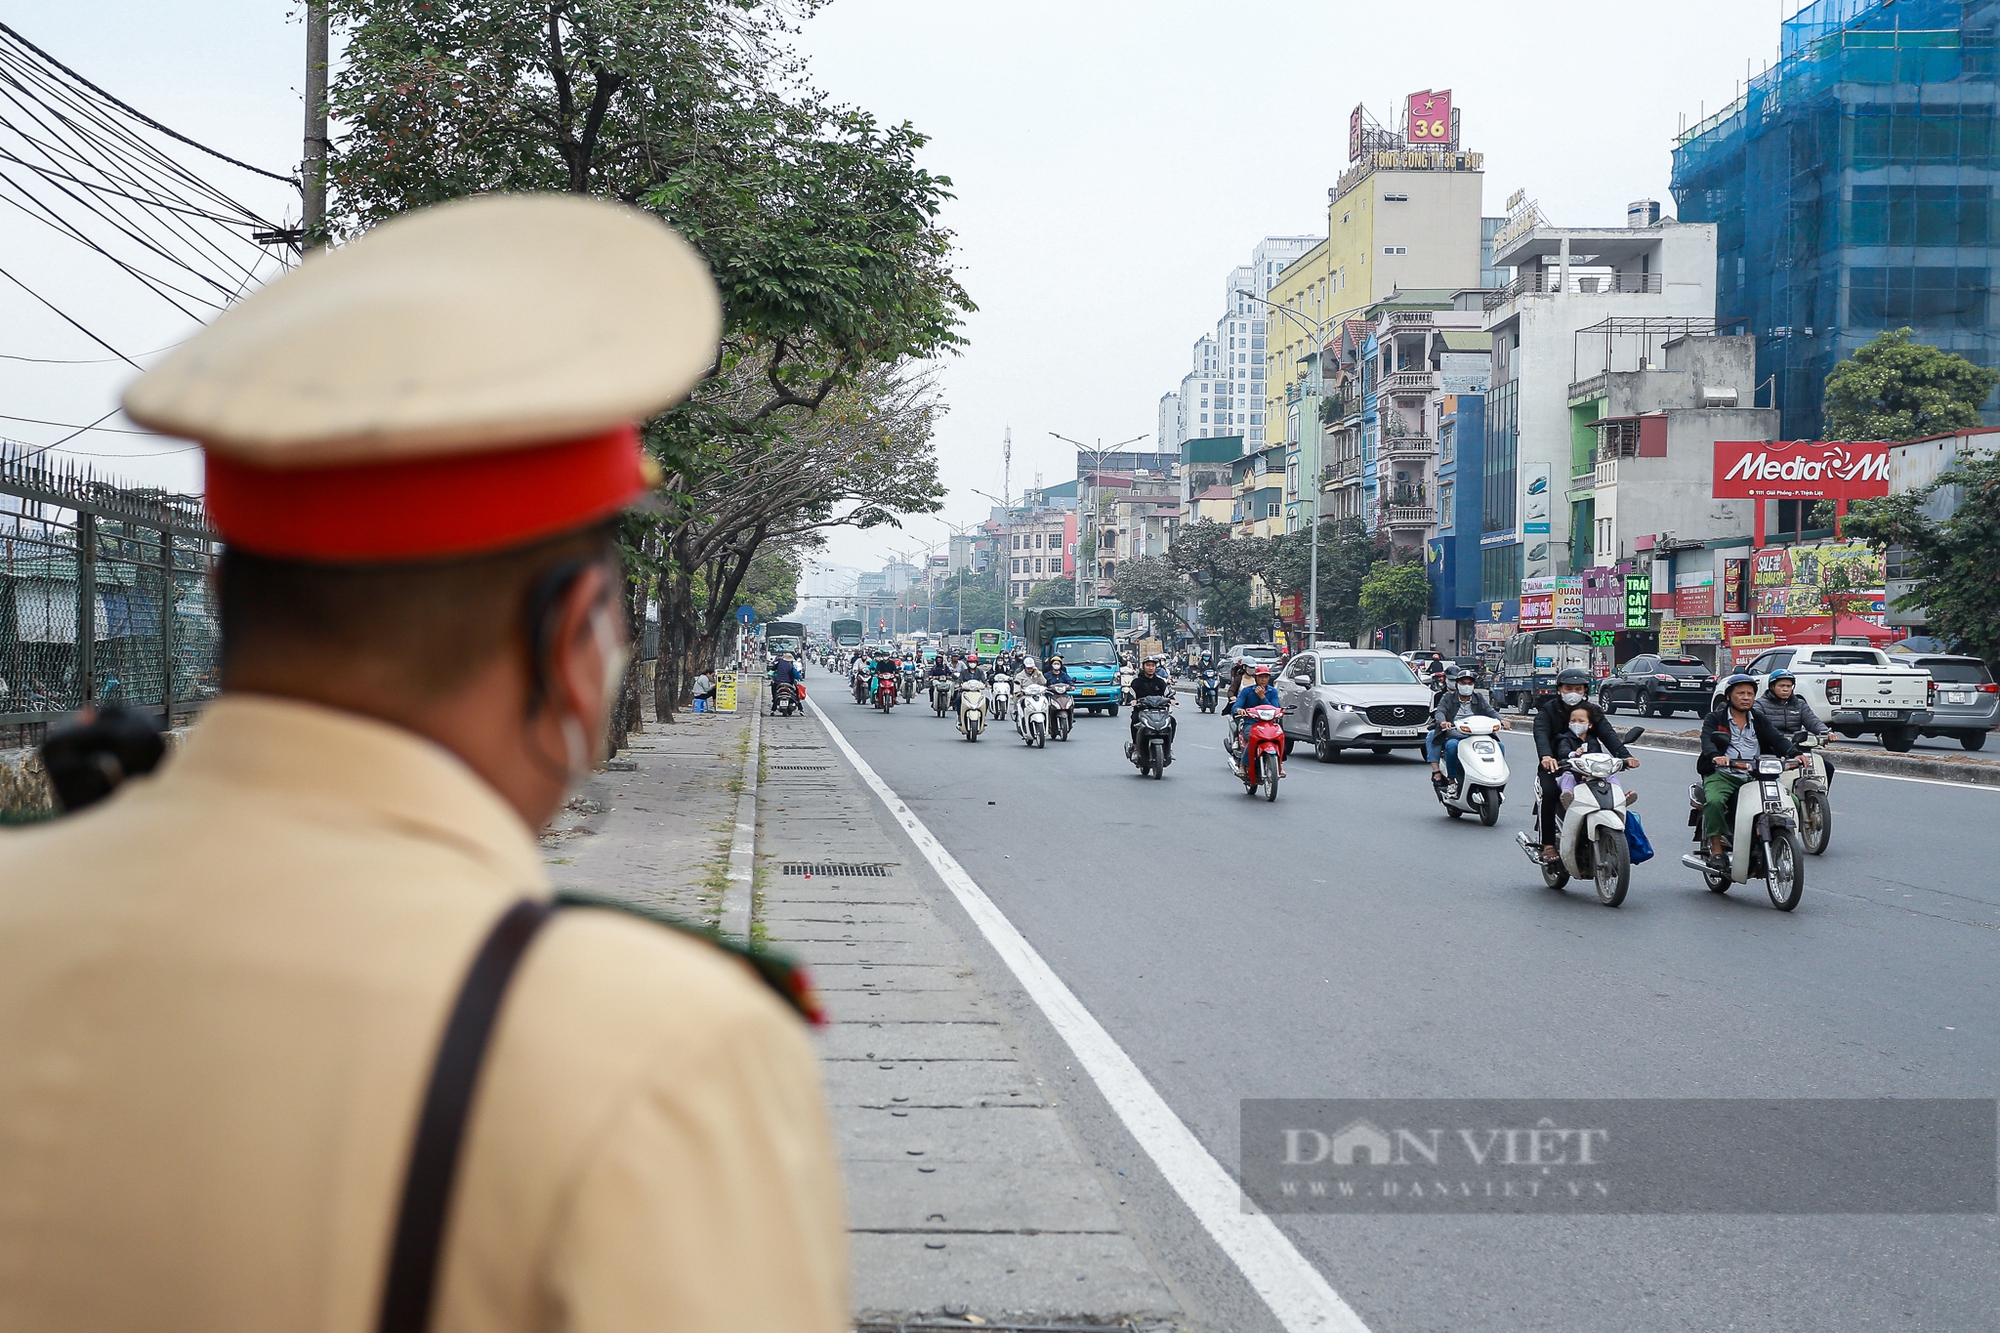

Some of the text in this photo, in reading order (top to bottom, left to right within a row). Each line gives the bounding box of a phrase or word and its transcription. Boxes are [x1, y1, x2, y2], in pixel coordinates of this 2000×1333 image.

[1414, 119, 1445, 138] 36
[1431, 152, 1441, 168] TY
[1444, 152, 1456, 168] 36
[1724, 452, 1822, 481] Media
[1757, 556, 1774, 572] SALE
[1627, 577, 1649, 590] TRÁI
[1563, 596, 1581, 605] CÁO
[1628, 592, 1648, 606] CÂY
